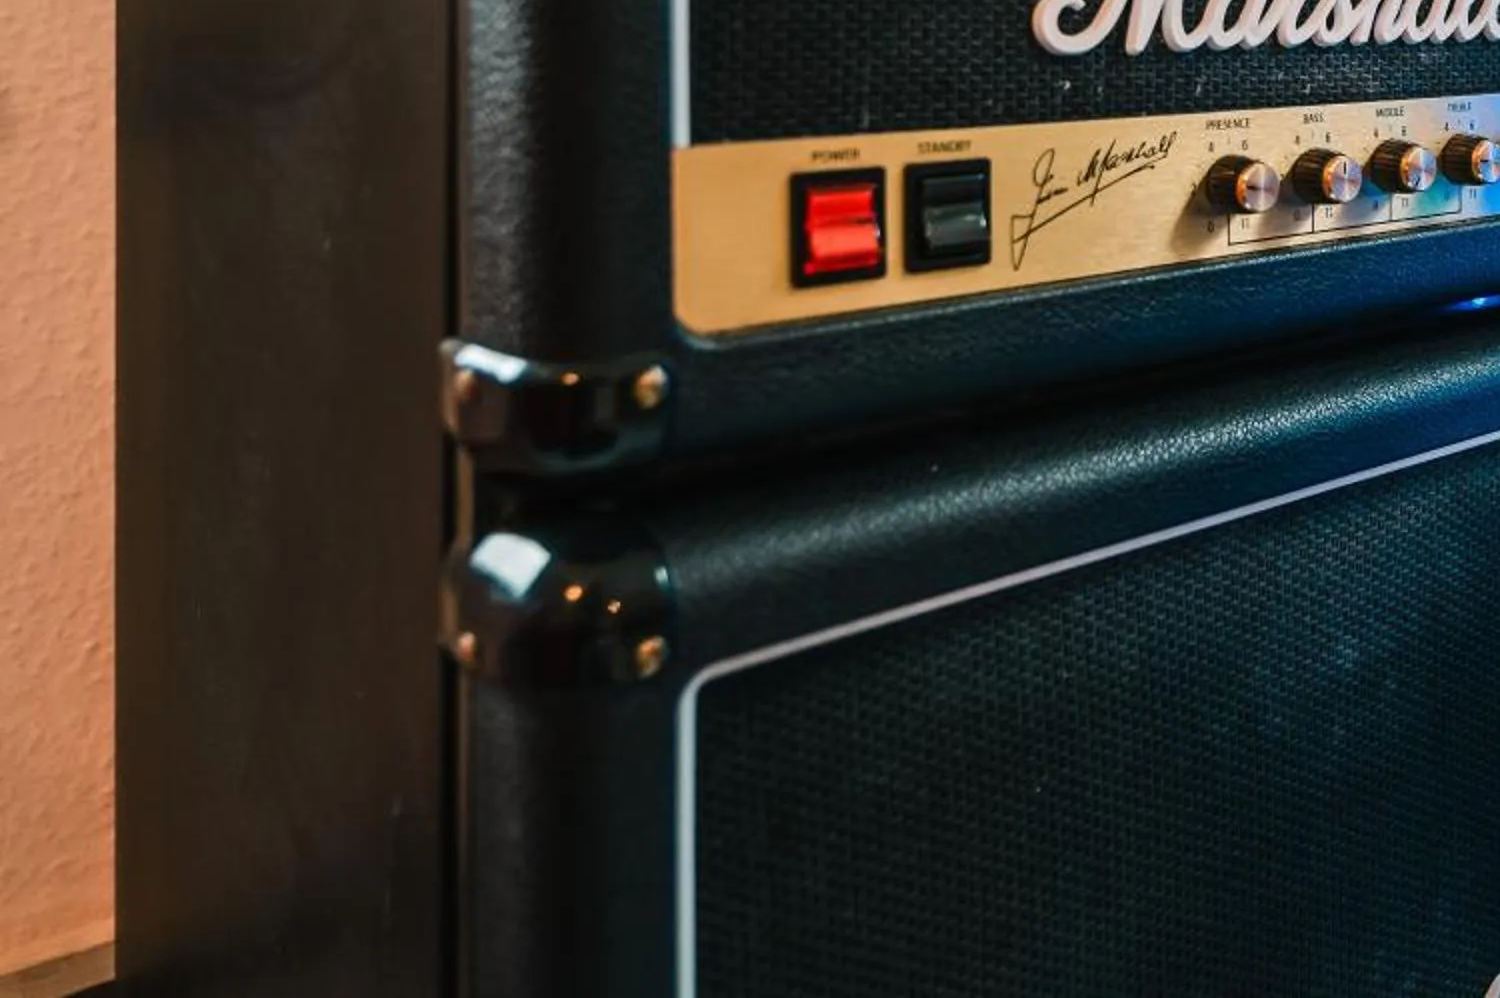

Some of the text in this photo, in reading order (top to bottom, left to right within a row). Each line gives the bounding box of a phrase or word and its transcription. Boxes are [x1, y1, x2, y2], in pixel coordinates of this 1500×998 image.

[1205, 117, 1250, 131] PRESENCE
[1303, 113, 1325, 124] BASS
[916, 139, 972, 155] STANDBY
